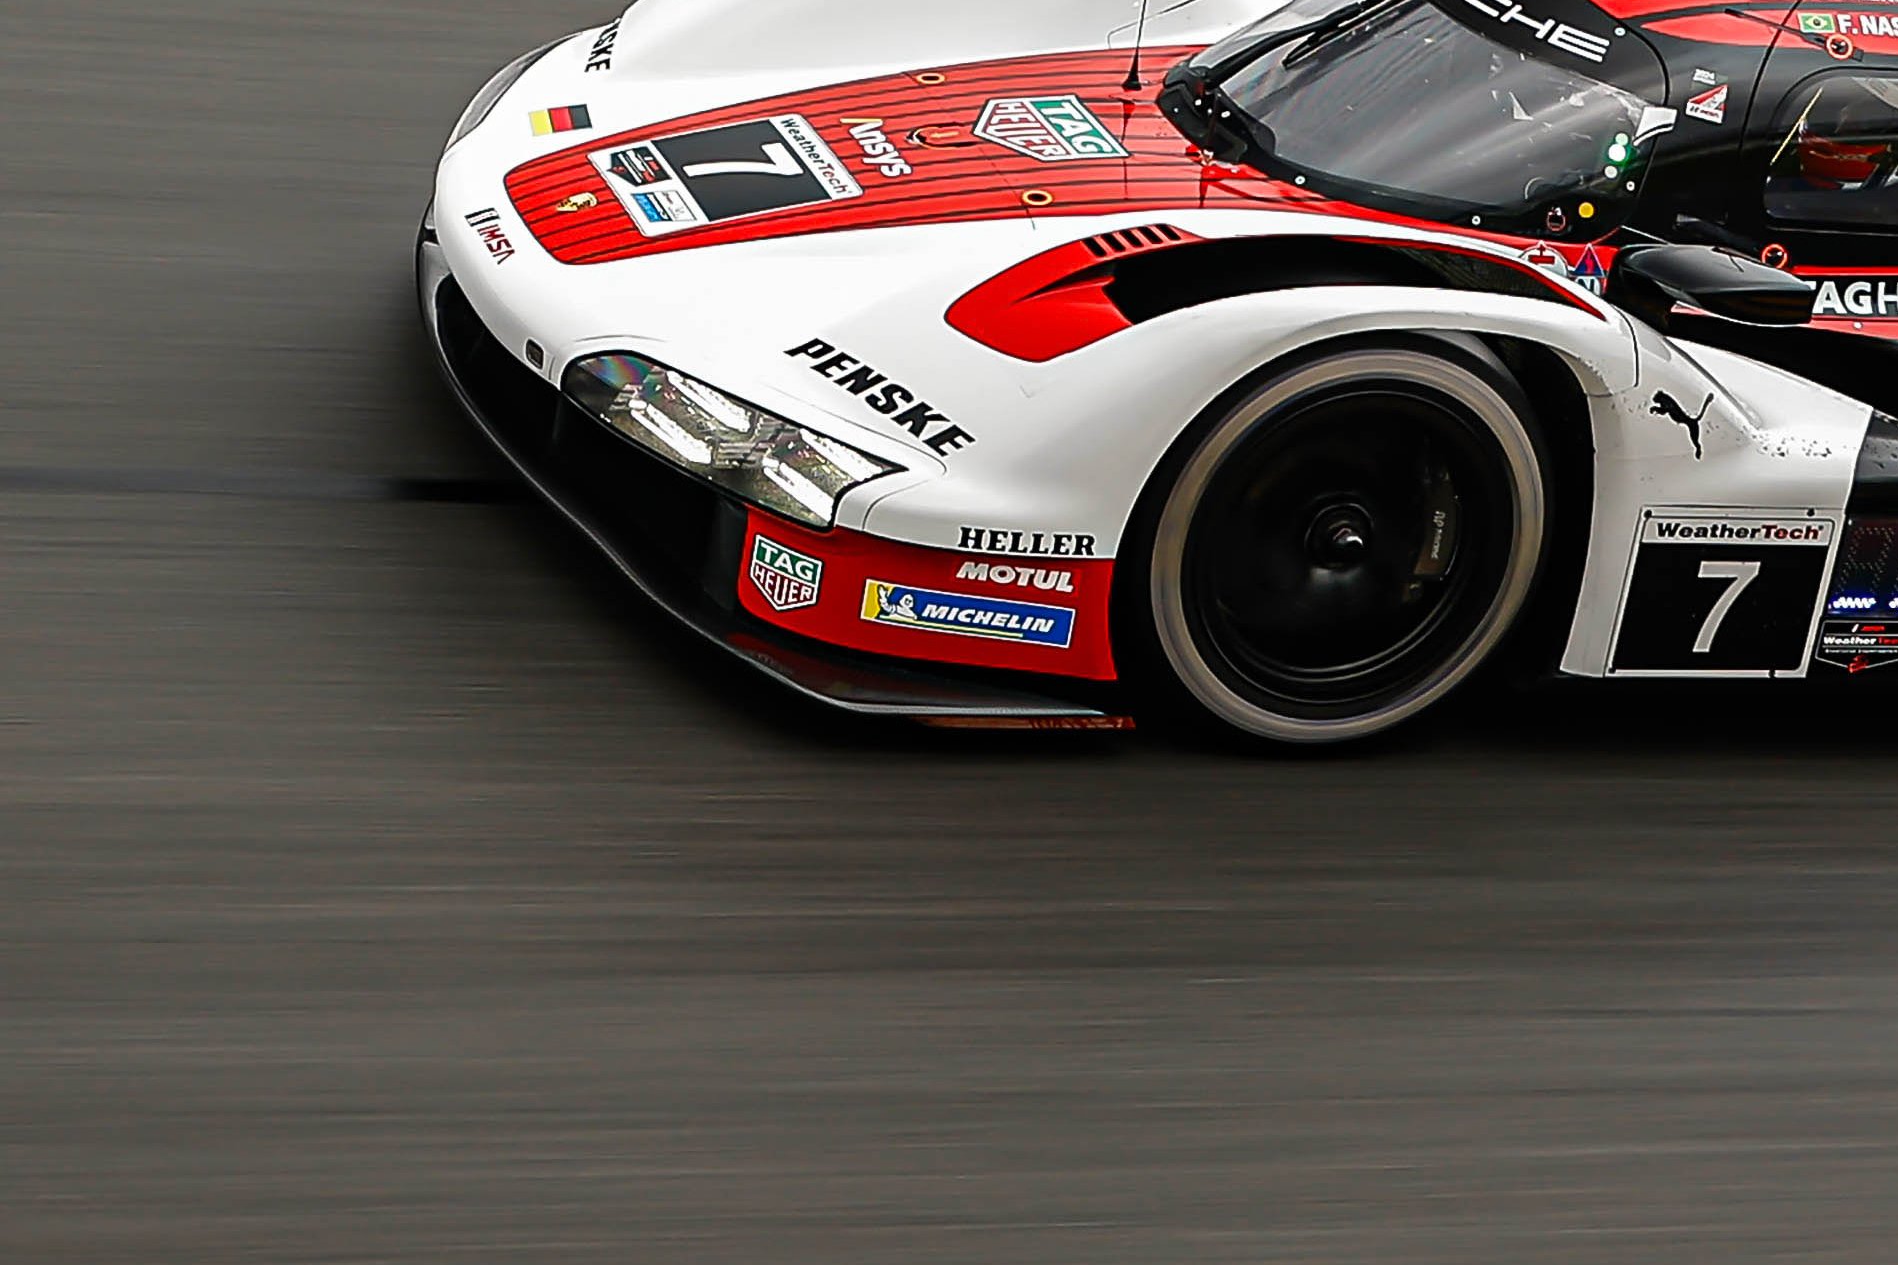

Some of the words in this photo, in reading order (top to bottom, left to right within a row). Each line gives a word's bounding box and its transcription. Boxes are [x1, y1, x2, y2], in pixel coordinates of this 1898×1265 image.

[986, 101, 1060, 158] HEUER
[1036, 100, 1114, 155] TAG
[681, 142, 804, 177] 7
[784, 337, 976, 458] PENSKE
[957, 526, 1096, 557] HELLER
[1657, 522, 1817, 541] WeatherTech
[758, 542, 815, 582] TAG
[956, 561, 1075, 593] MOTUL
[753, 564, 814, 605] HEUER
[921, 603, 1055, 633] MICHELIN
[1692, 560, 1761, 653] 7
